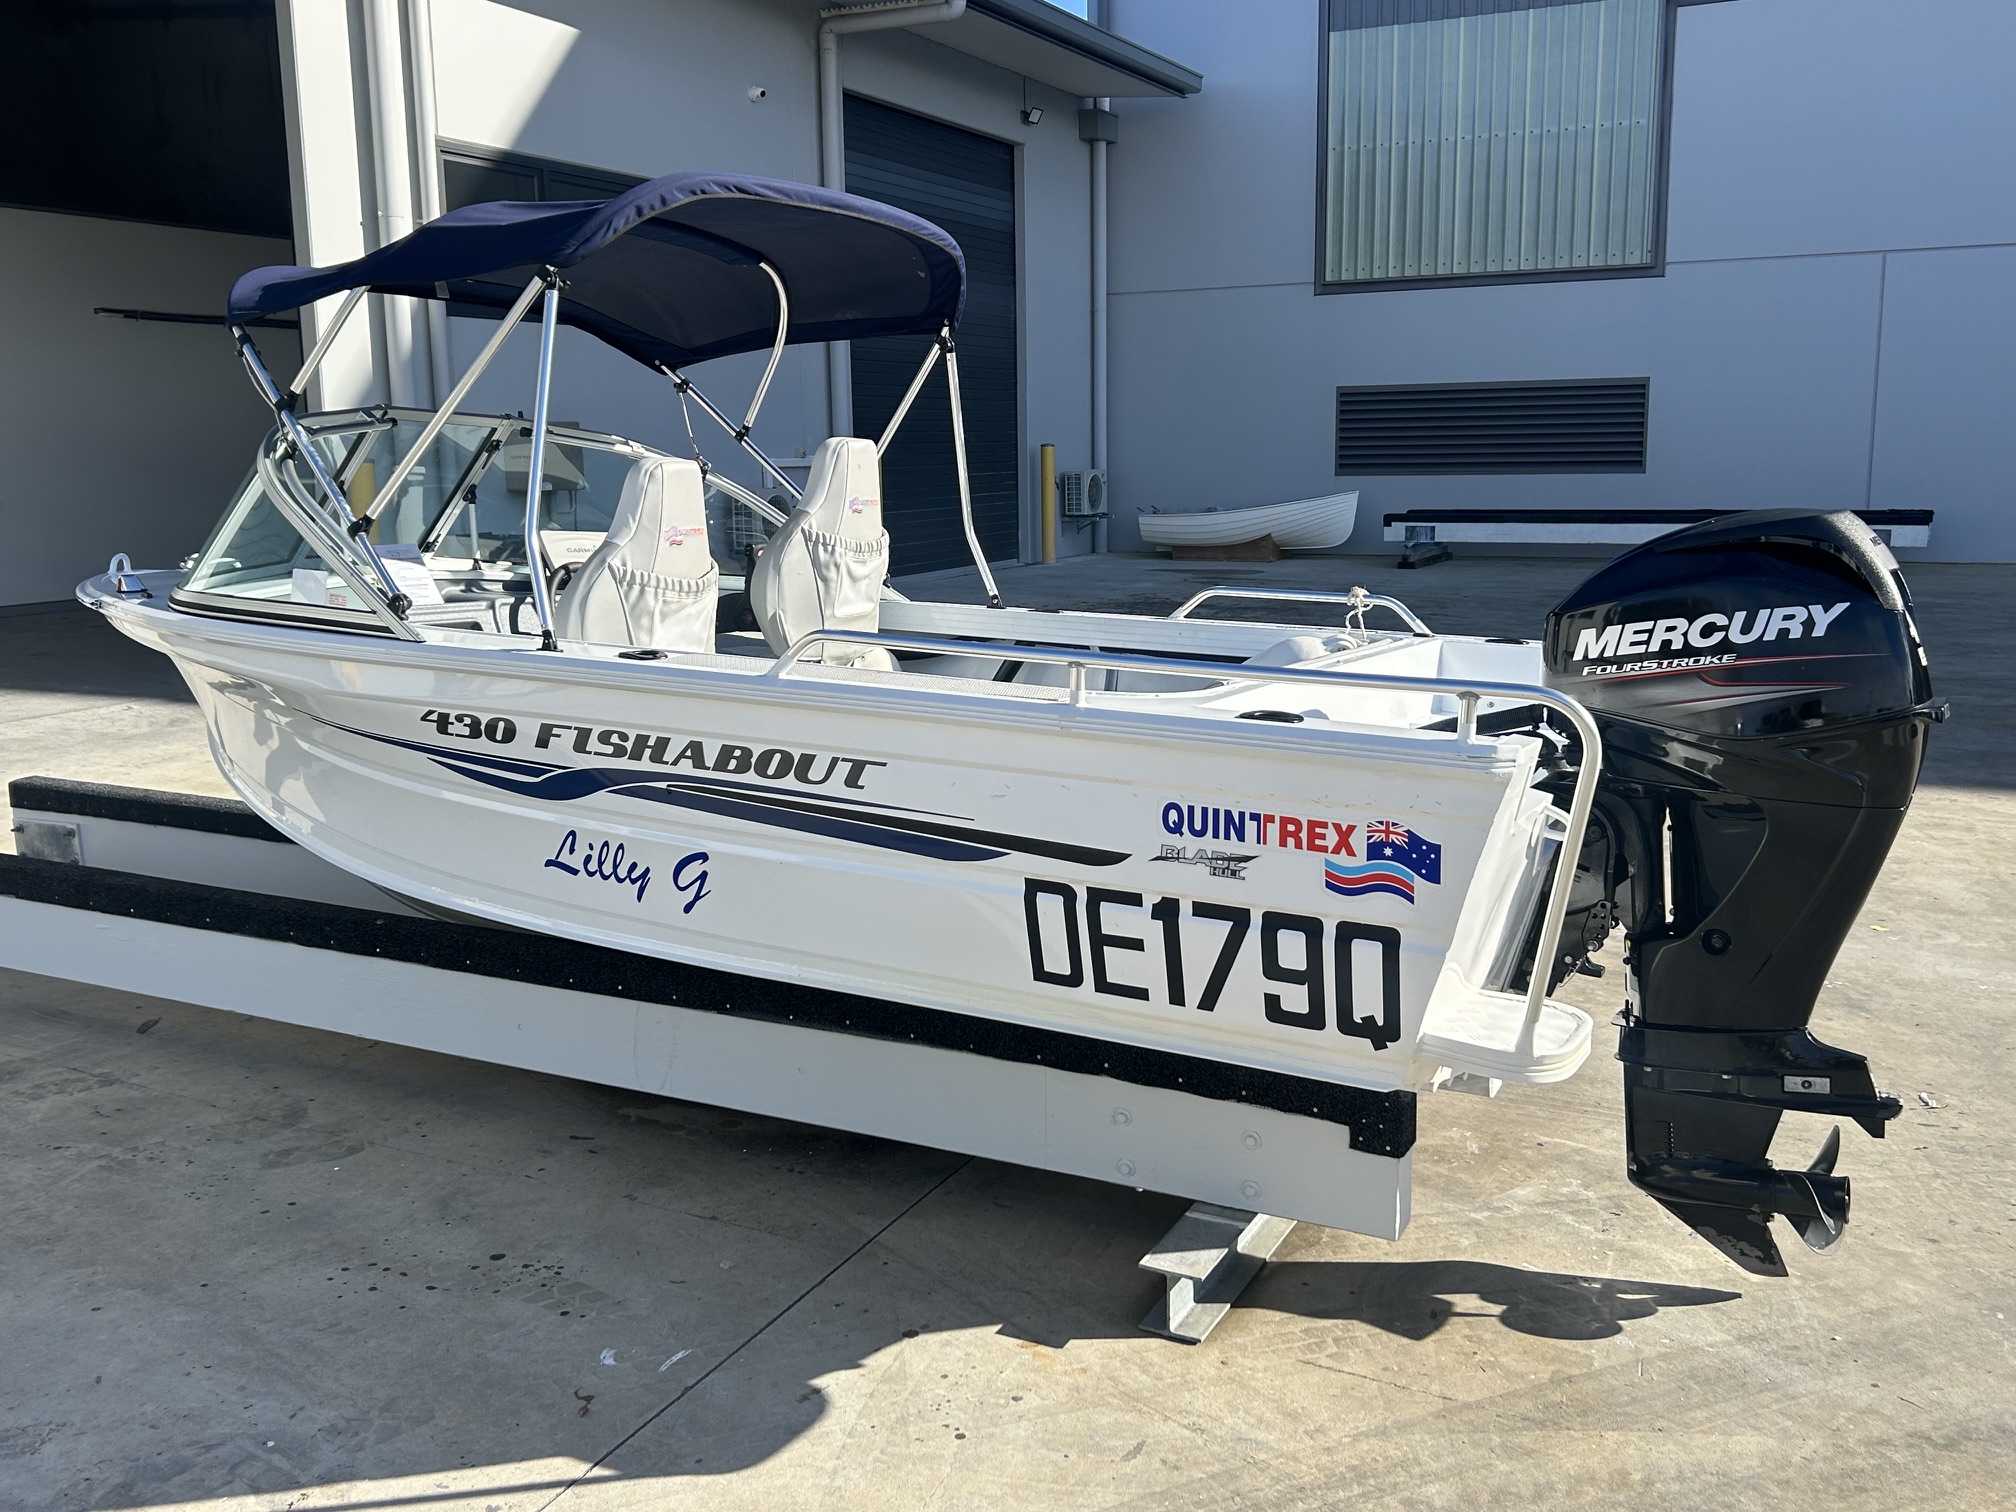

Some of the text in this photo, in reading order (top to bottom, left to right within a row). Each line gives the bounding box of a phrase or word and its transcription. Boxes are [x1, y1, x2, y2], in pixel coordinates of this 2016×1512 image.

[1573, 602, 1851, 662] MERCURY
[1581, 653, 1738, 677] FOURSTROKE
[420, 709, 888, 790] 430 FISHABOUT
[1160, 843, 1258, 871] BLADE
[1161, 801, 1357, 858] QUINTREX
[544, 829, 712, 914] Lilly G
[1209, 866, 1246, 880] HULL
[1024, 877, 1401, 1051] DE179Q
